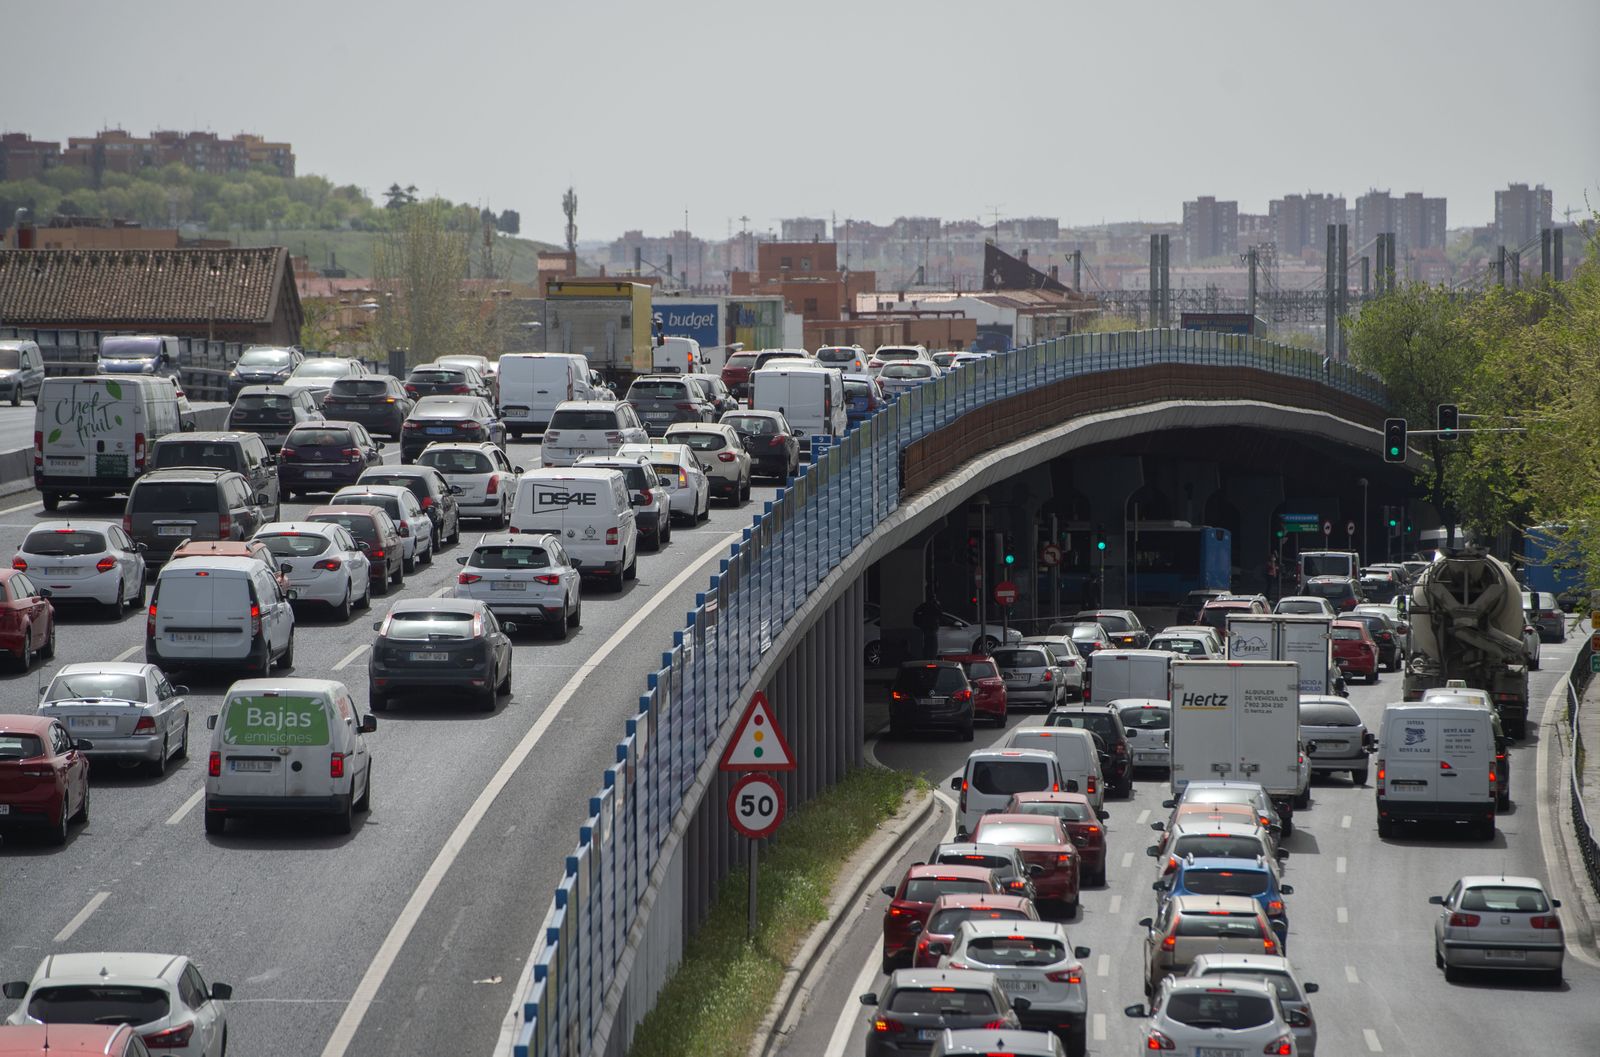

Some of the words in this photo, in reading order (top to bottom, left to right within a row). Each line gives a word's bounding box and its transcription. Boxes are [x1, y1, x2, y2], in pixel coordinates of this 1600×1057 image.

[668, 312, 715, 329] budget
[55, 384, 100, 425] Chef
[1181, 692, 1228, 707] Hertz
[246, 706, 312, 731] Bajas
[244, 731, 313, 744] emisiones
[740, 794, 774, 817] 50
